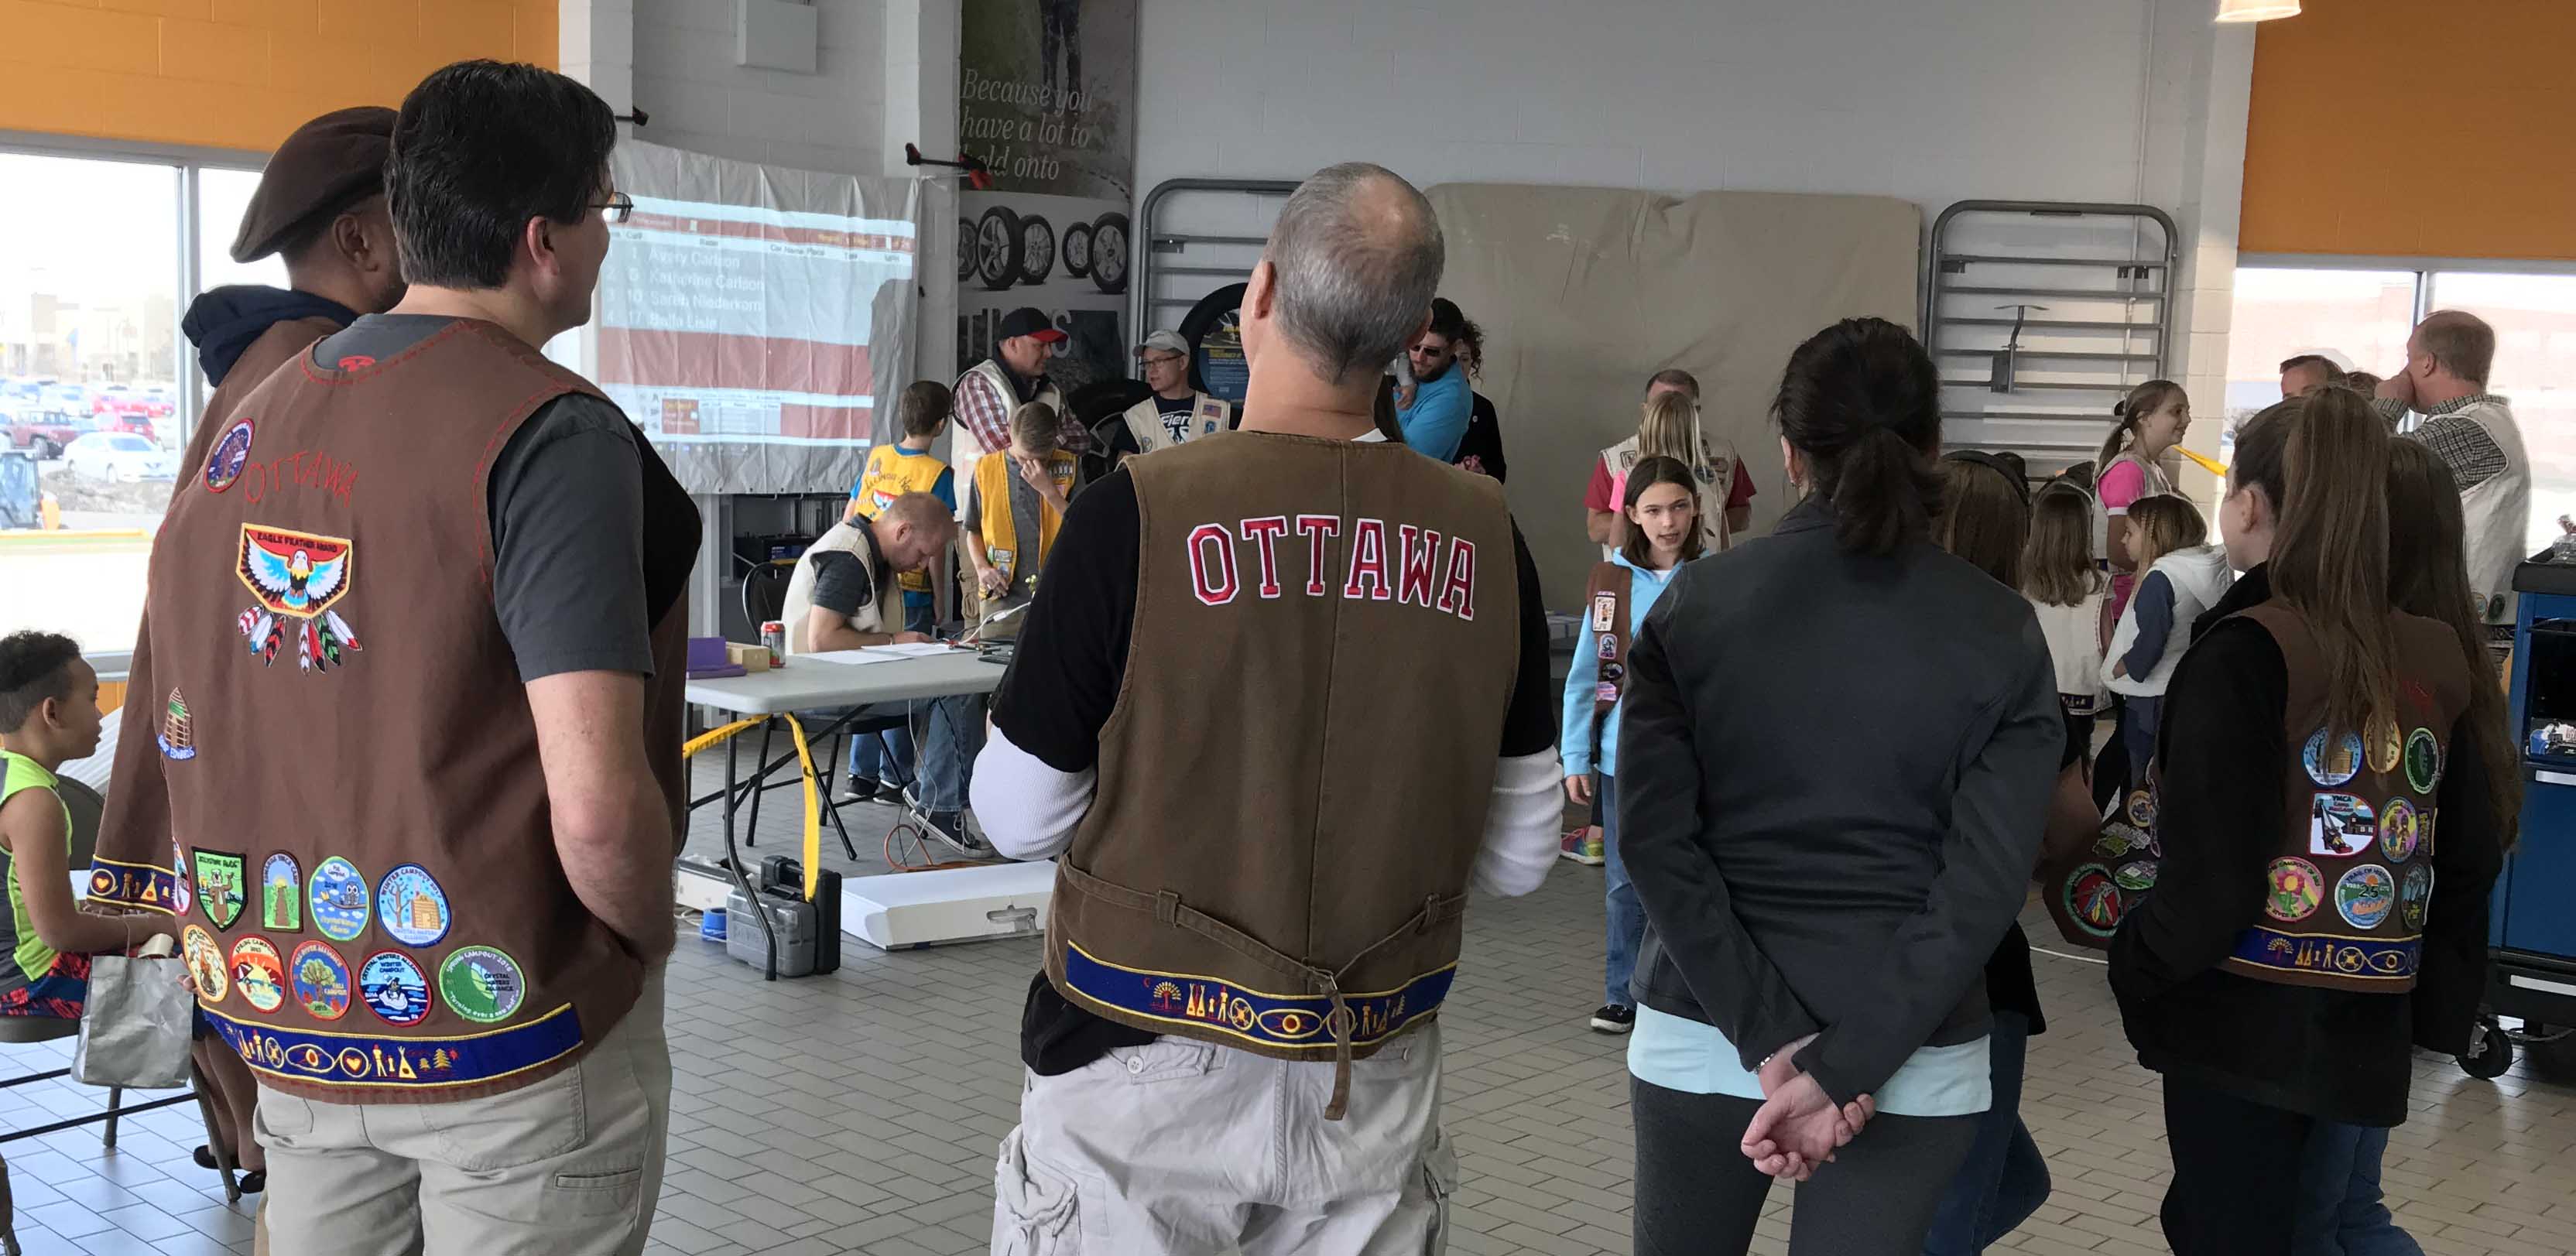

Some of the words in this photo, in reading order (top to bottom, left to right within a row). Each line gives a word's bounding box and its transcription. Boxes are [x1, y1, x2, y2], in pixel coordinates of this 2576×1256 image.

[960, 68, 1050, 107] Because
[1052, 88, 1092, 117] you
[960, 106, 1014, 139] have
[1019, 119, 1032, 142] a
[1039, 113, 1066, 145] lot
[1070, 121, 1091, 148] to
[961, 145, 1009, 177] old
[1014, 155, 1060, 180] onto
[649, 248, 688, 269] Avery
[691, 252, 740, 269] Carlson
[649, 269, 711, 287] Katherine
[715, 275, 765, 291] Carlson
[245, 450, 358, 508] OTTAWA
[257, 532, 283, 543] EAGLE
[284, 535, 317, 549] FEATHER
[317, 542, 337, 553] AWARD
[1187, 515, 1475, 621] OTTAWA
[381, 872, 399, 895] WINTER
[401, 868, 430, 882] CAMPOUT
[2359, 885, 2379, 898] 25
[235, 939, 252, 953] SPRING
[361, 959, 378, 981] CRYSTAL
[377, 953, 401, 961] WATERS
[446, 954, 464, 973] SPRING
[464, 950, 498, 960] CAMPOUT
[496, 957, 514, 972] 2016
